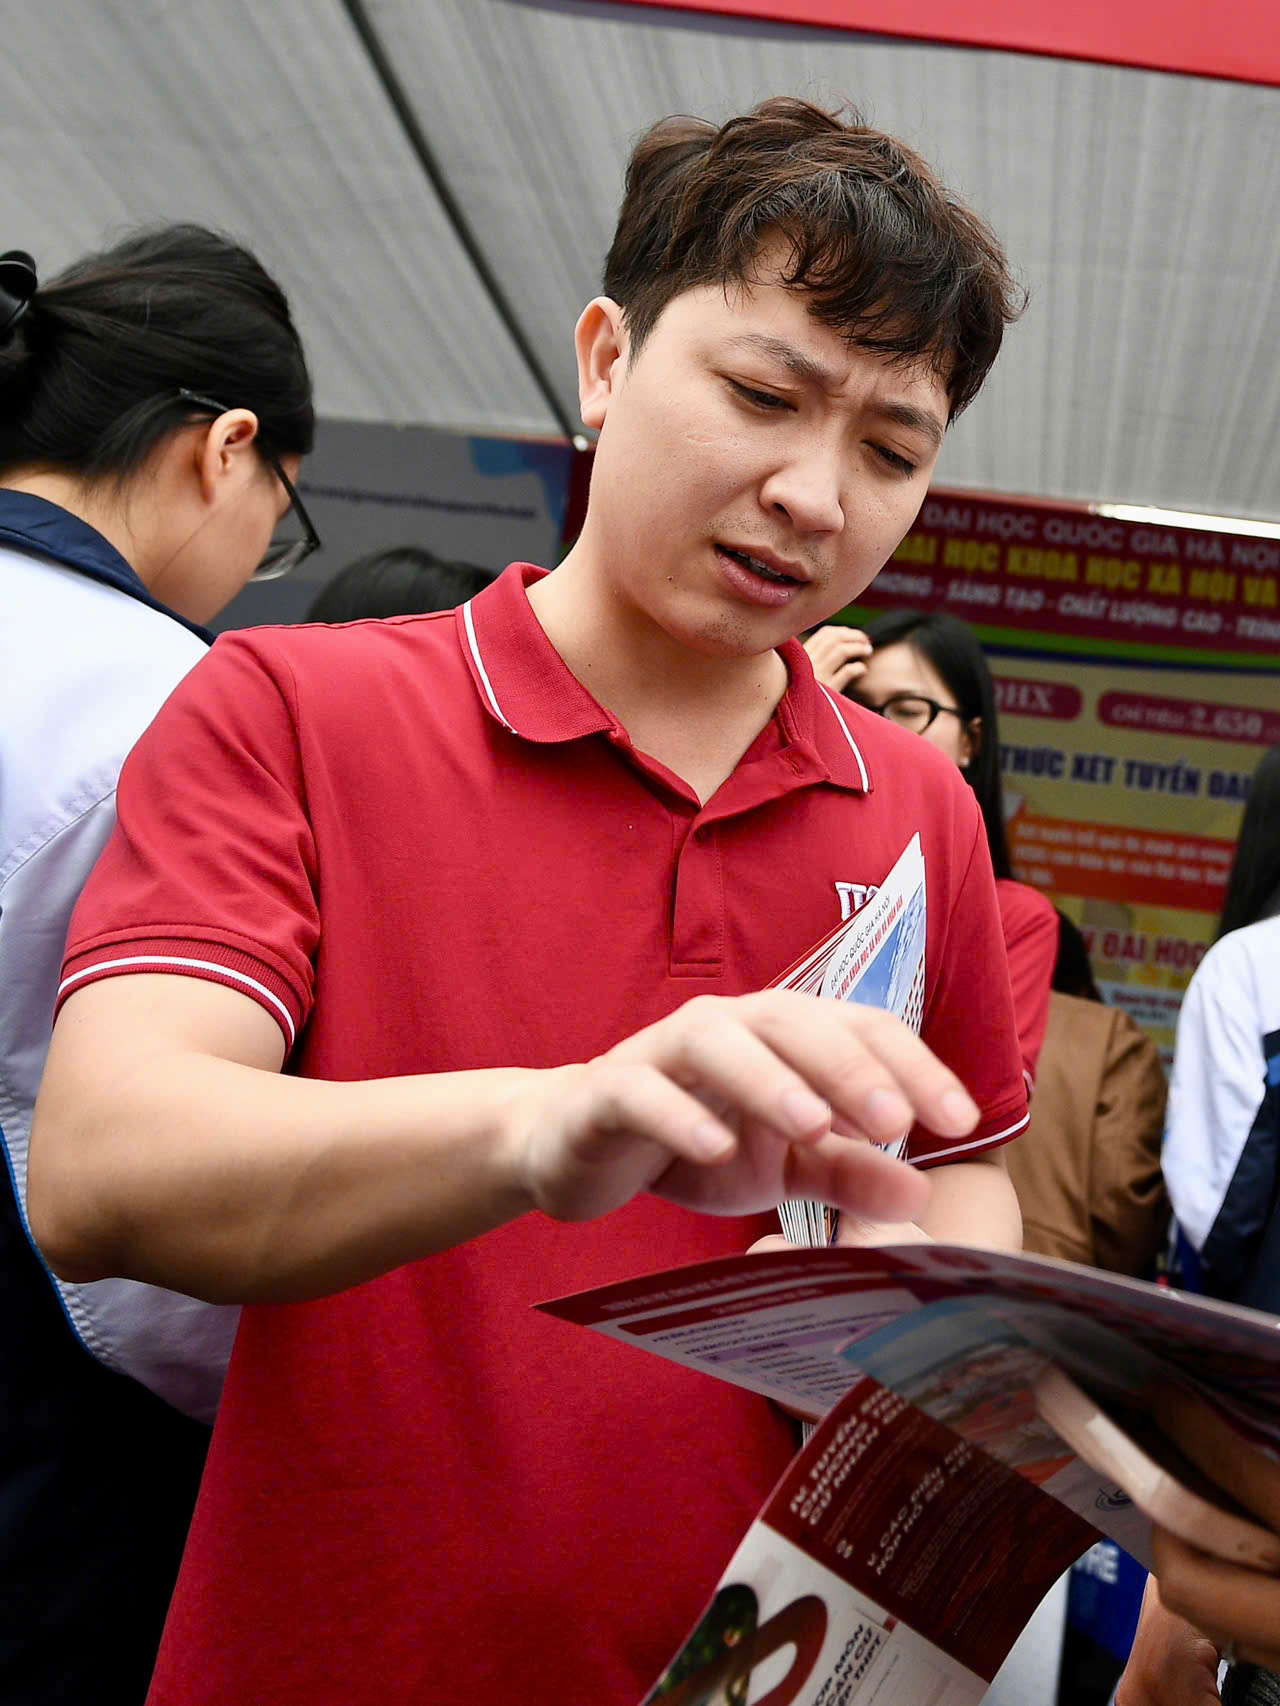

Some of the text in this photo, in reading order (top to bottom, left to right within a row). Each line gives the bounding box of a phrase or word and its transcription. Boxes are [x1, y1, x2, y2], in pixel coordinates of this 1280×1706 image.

[923, 503, 971, 533] ĐẠI
[976, 508, 1036, 541] HỌC
[1043, 514, 1126, 549] QUỐC
[1132, 529, 1179, 557] GIA
[1231, 541, 1280, 570] NỘI
[943, 537, 999, 576] HỌC
[1007, 545, 1078, 582] KHOA
[1085, 555, 1142, 591] HỌC
[1182, 608, 1222, 634] CAO
[1123, 754, 1201, 796] TUYỂN
